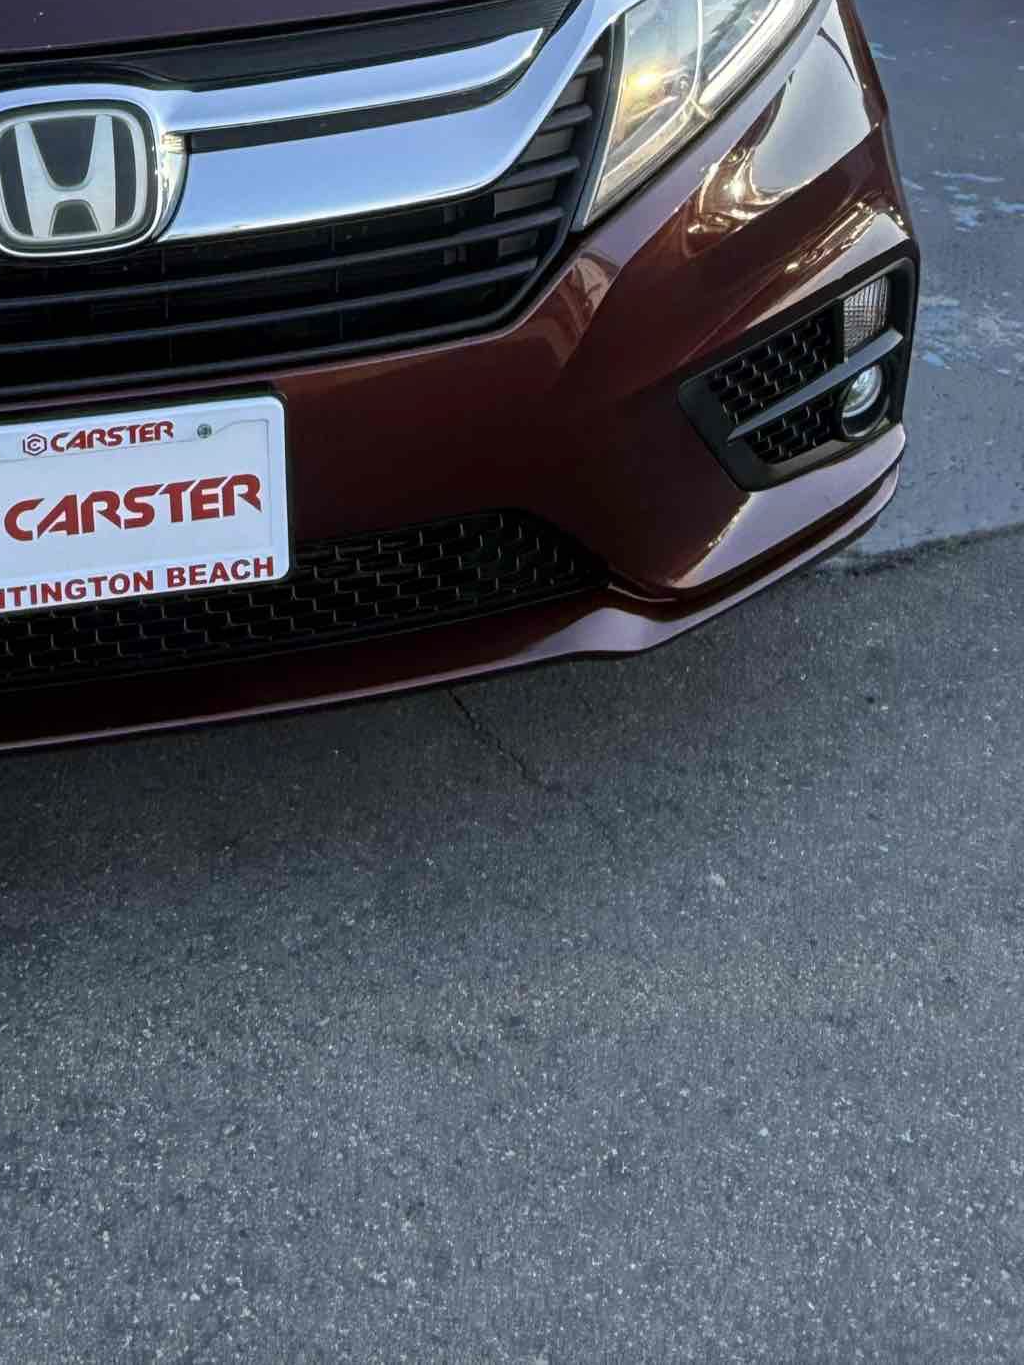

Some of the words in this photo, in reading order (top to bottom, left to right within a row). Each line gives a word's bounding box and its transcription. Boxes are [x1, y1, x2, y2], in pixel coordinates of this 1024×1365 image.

[50, 421, 174, 453] CARSTER
[3, 473, 263, 542] CARSTER
[166, 556, 275, 589] BEACH
